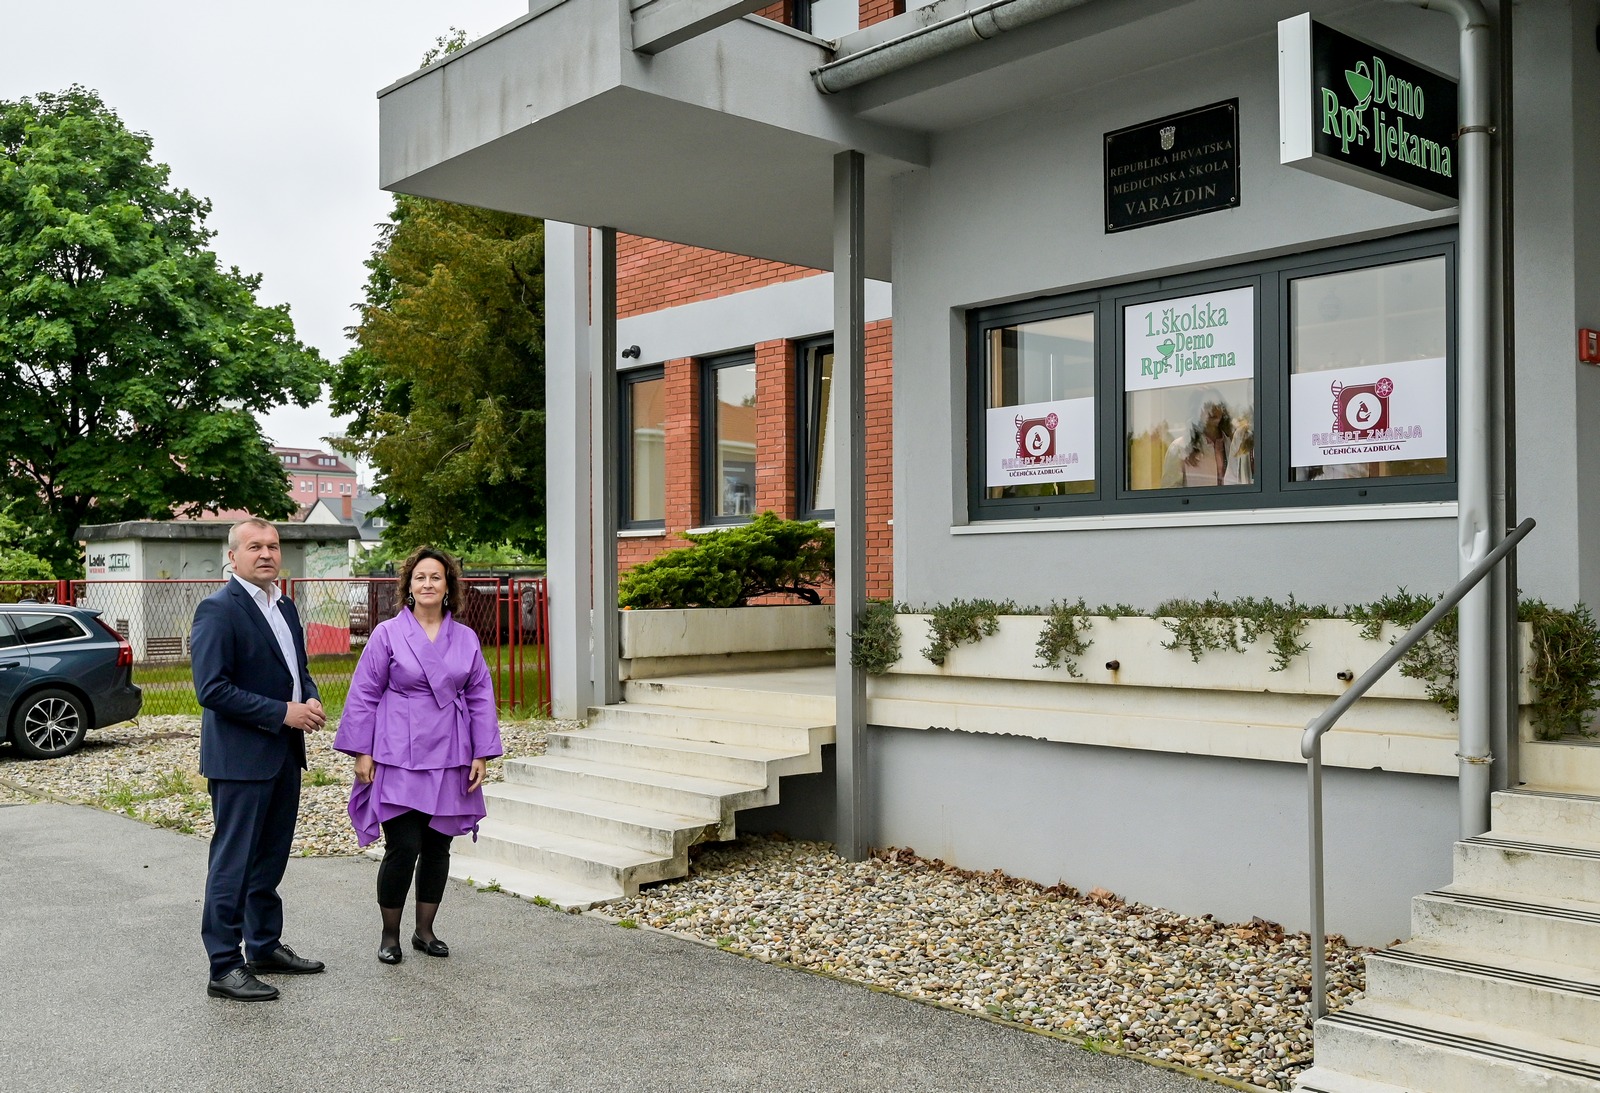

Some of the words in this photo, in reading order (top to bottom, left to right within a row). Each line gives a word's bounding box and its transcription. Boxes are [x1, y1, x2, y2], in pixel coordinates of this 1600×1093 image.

[1373, 56, 1424, 119] Demo
[1373, 107, 1452, 177] ljekarna
[1110, 156, 1168, 178] REPUBLIKA
[1172, 140, 1232, 162] HRVATSKA
[1113, 170, 1185, 195] MEDICINSKA
[1125, 183, 1217, 215] VARAŽDIN
[1175, 332, 1214, 352] Demo
[1175, 351, 1236, 377] ljekarna
[1312, 430, 1361, 446] RECEPT
[1366, 425, 1423, 442] ZNANJA
[1323, 447, 1362, 456] UČENIČKA
[1363, 444, 1400, 453] ZADRUGA
[1009, 470, 1037, 478] UČENIČKA
[1037, 468, 1064, 476] ZADRUGA
